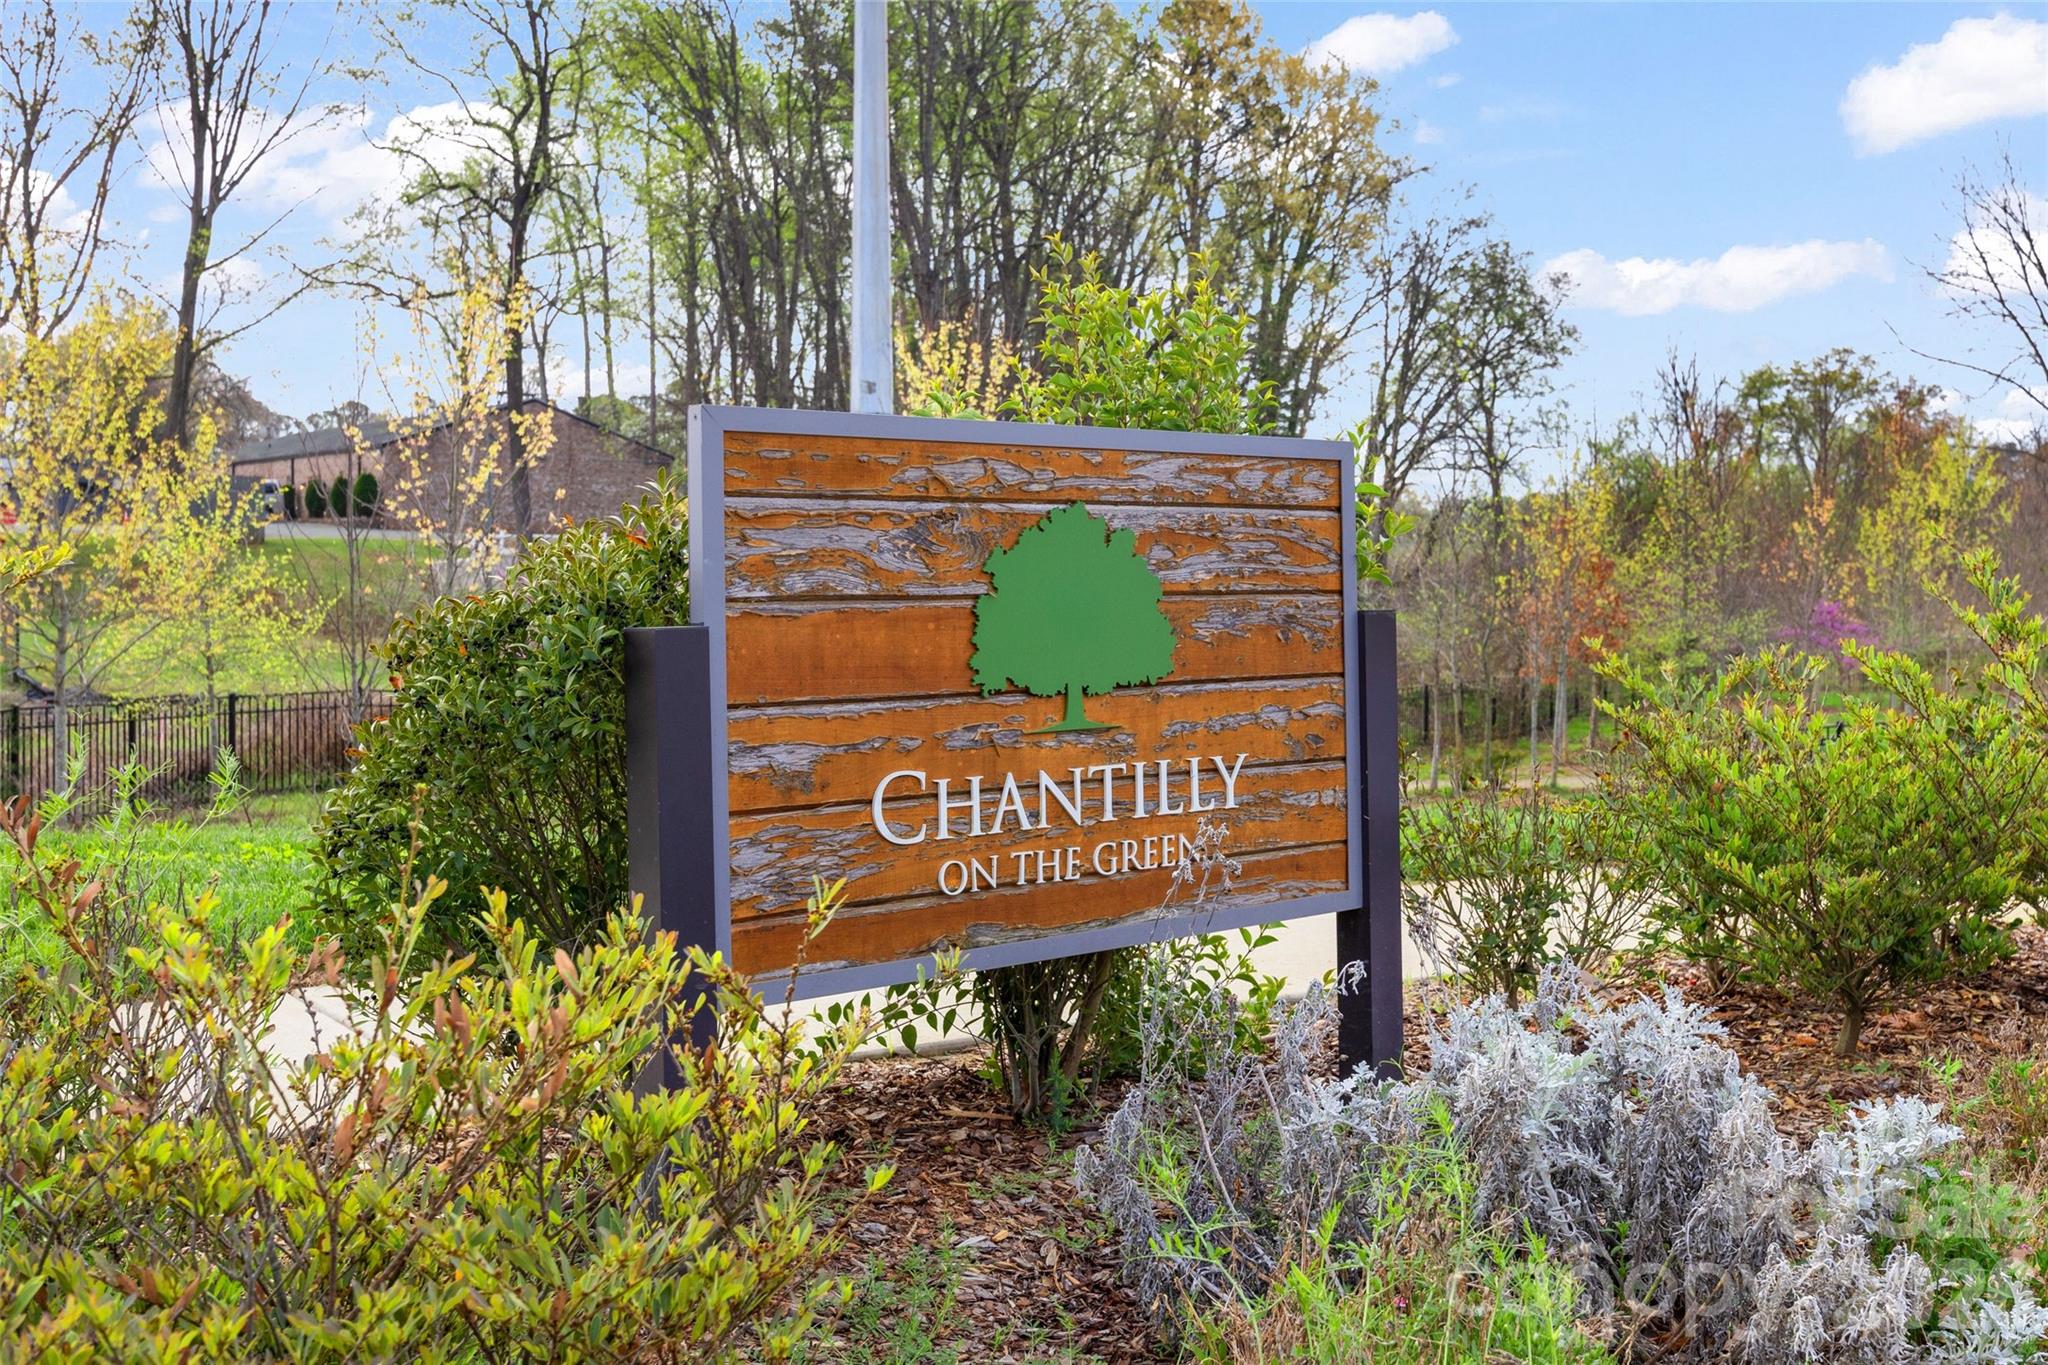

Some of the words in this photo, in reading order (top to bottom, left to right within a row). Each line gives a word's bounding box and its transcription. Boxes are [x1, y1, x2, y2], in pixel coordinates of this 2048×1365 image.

[871, 753, 1249, 845] CHANTILLY
[937, 855, 998, 895] ON
[1011, 847, 1081, 885] THE
